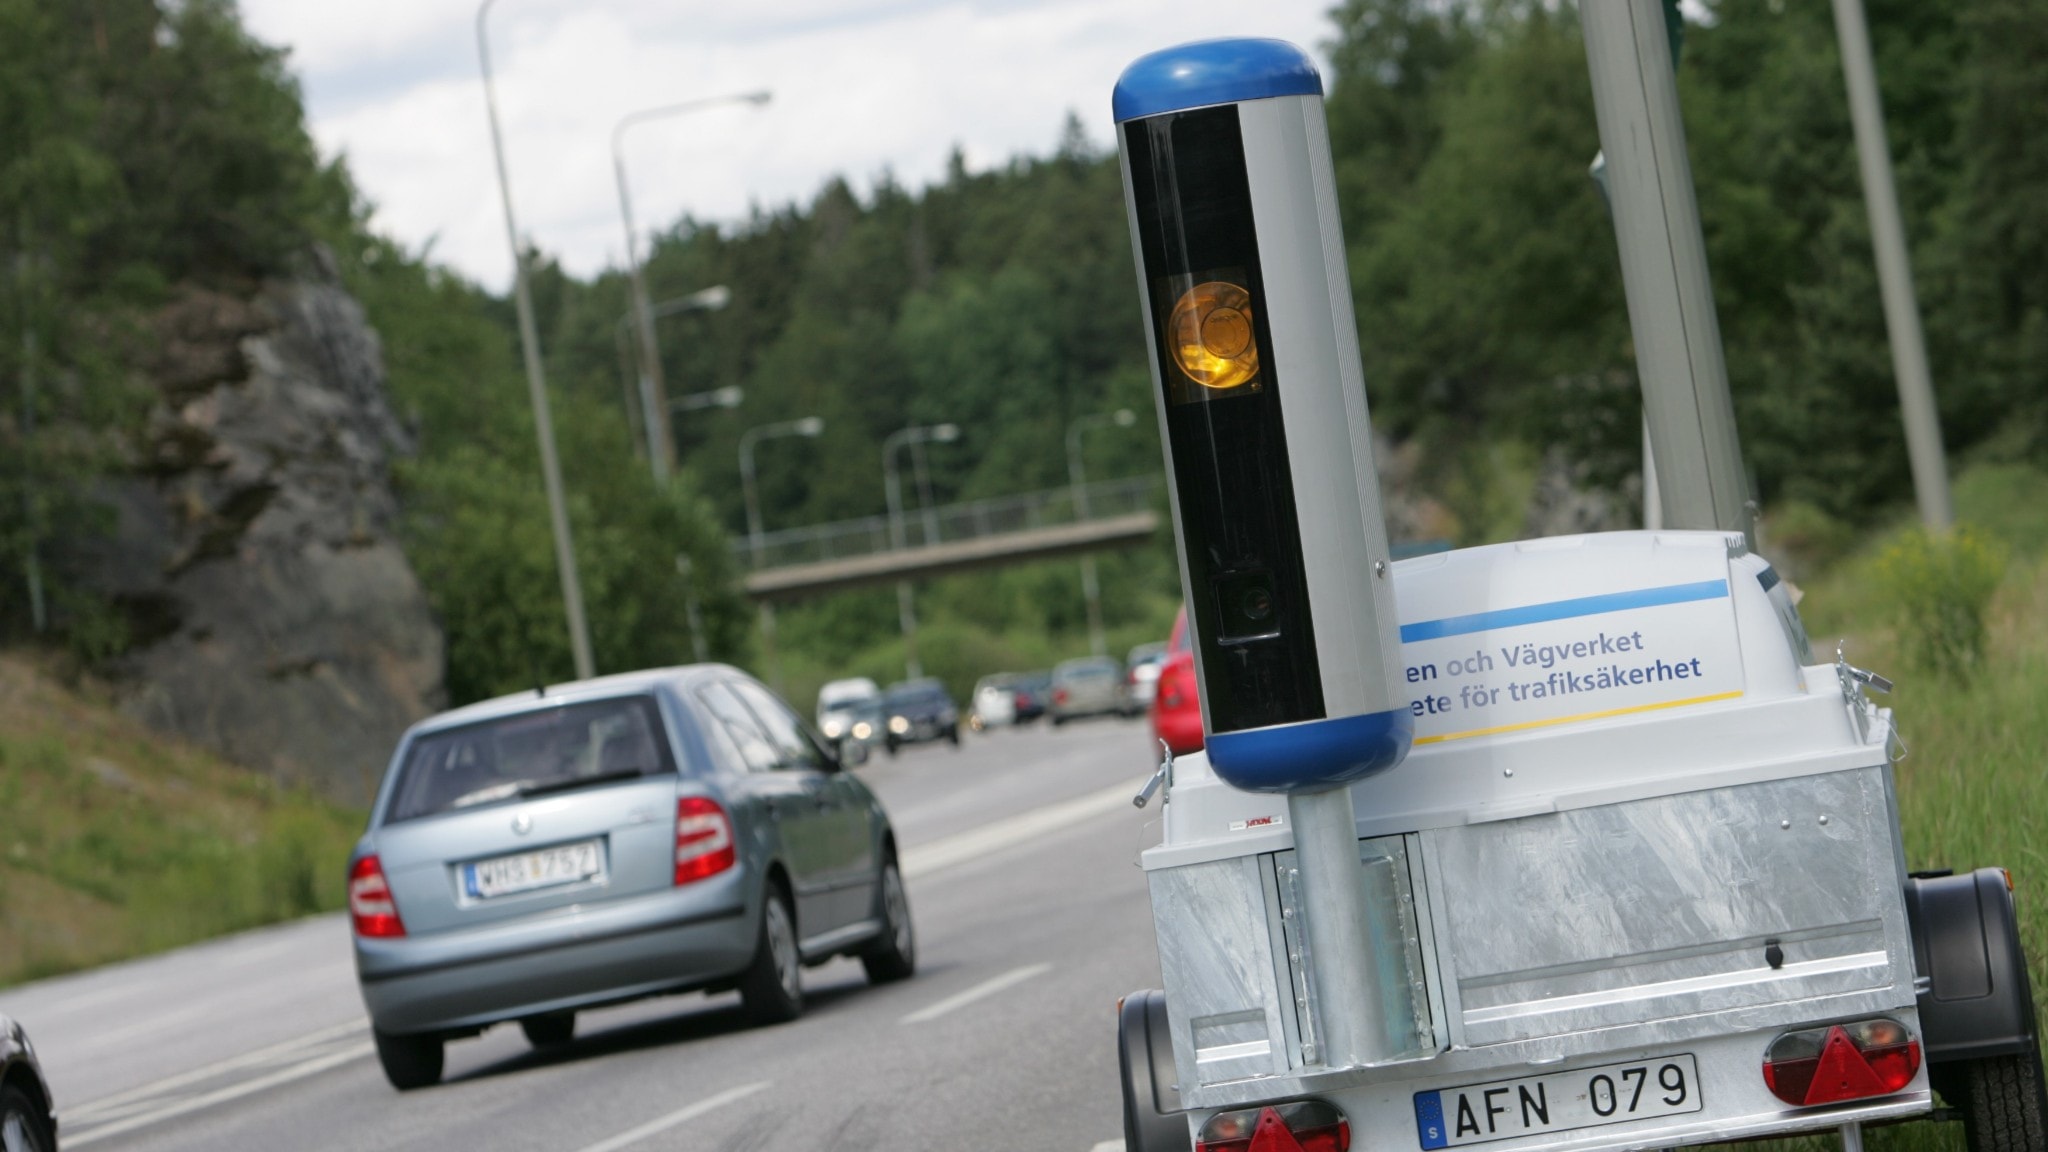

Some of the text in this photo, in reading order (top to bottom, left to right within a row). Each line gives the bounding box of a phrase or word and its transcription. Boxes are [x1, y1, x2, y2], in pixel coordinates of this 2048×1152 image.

[1446, 650, 1494, 676] och
[1501, 631, 1644, 668] Vägverket
[1460, 684, 1500, 709] för
[1508, 657, 1703, 702] trafiksäkerhet
[1456, 1063, 1687, 1138] AFN 079
[1428, 1126, 1438, 1139] S
